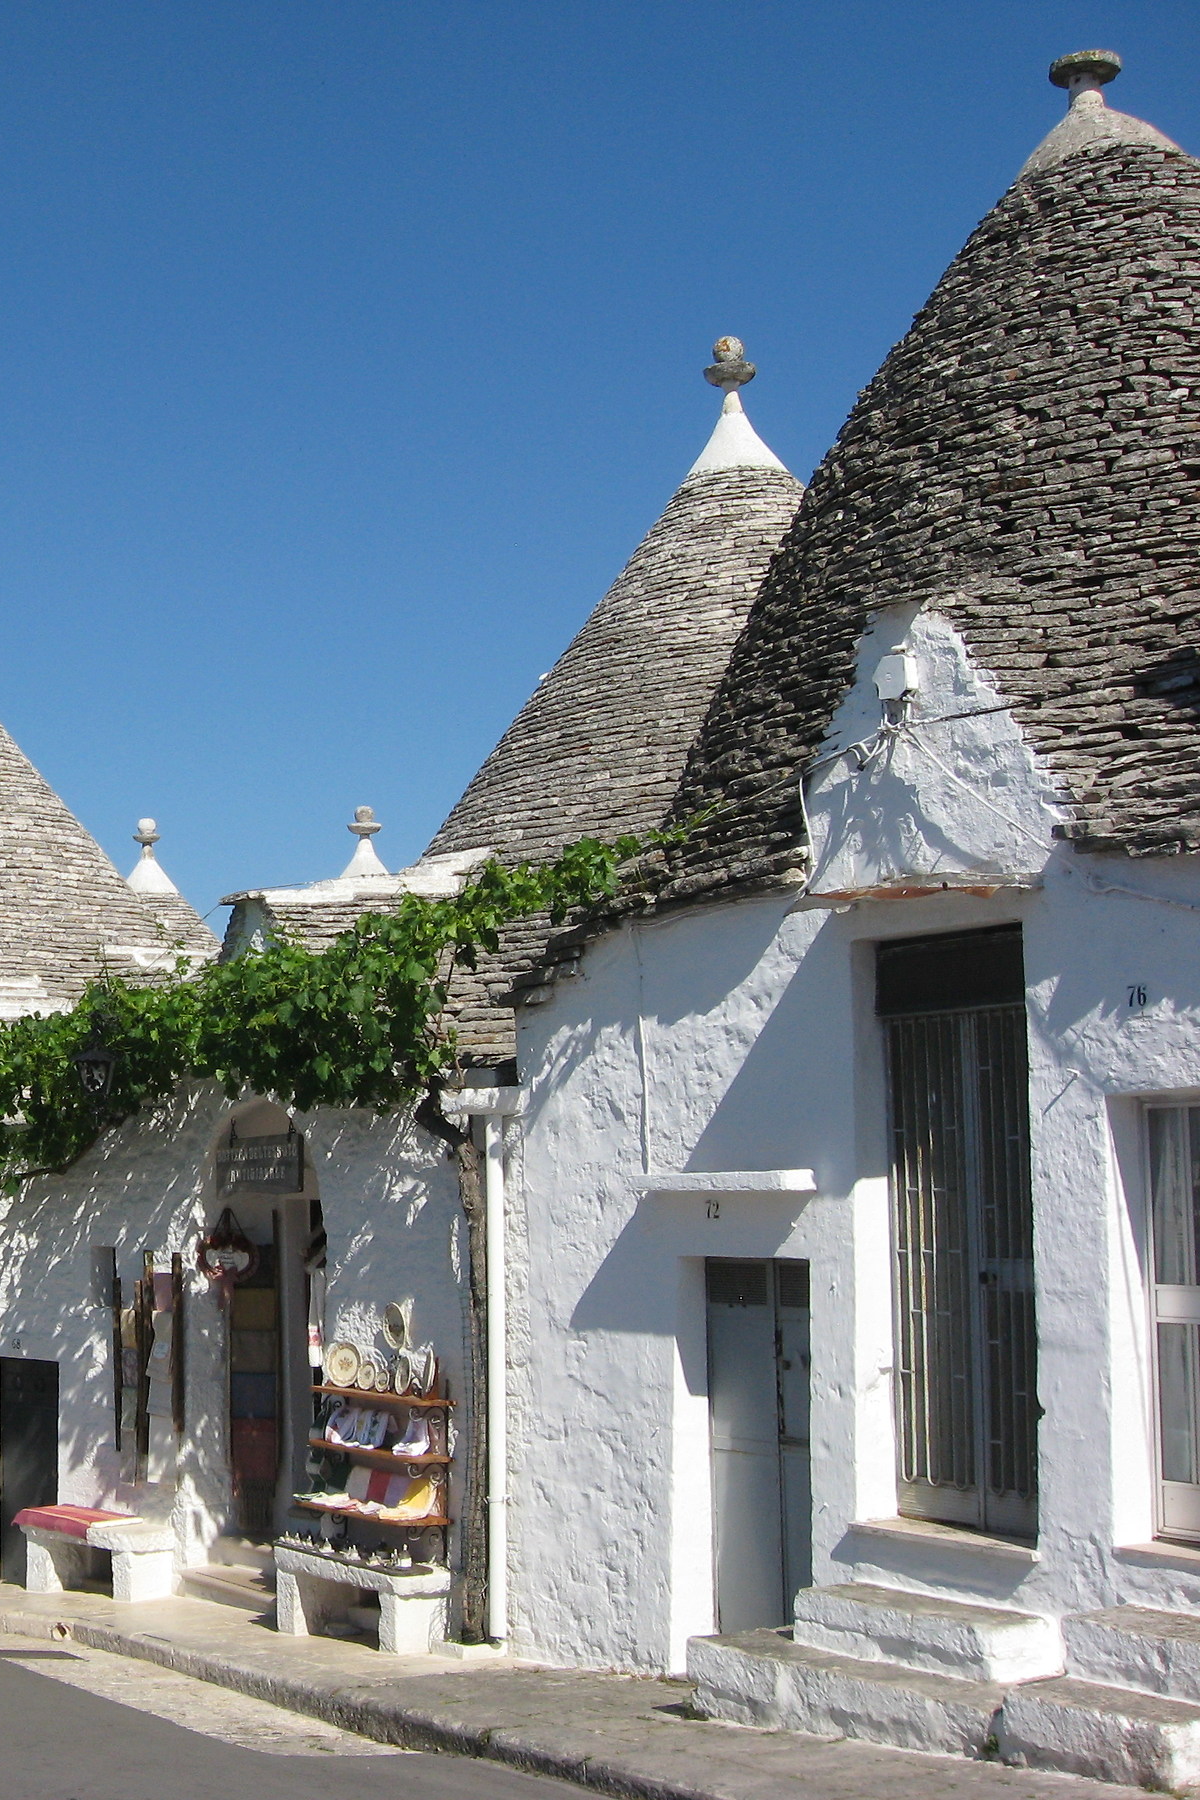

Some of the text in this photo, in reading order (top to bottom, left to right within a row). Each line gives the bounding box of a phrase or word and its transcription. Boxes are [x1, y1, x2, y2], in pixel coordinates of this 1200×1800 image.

[1127, 986, 1146, 1007] 76
[705, 1199, 720, 1219] 72
[11, 1338, 21, 1350] 68
